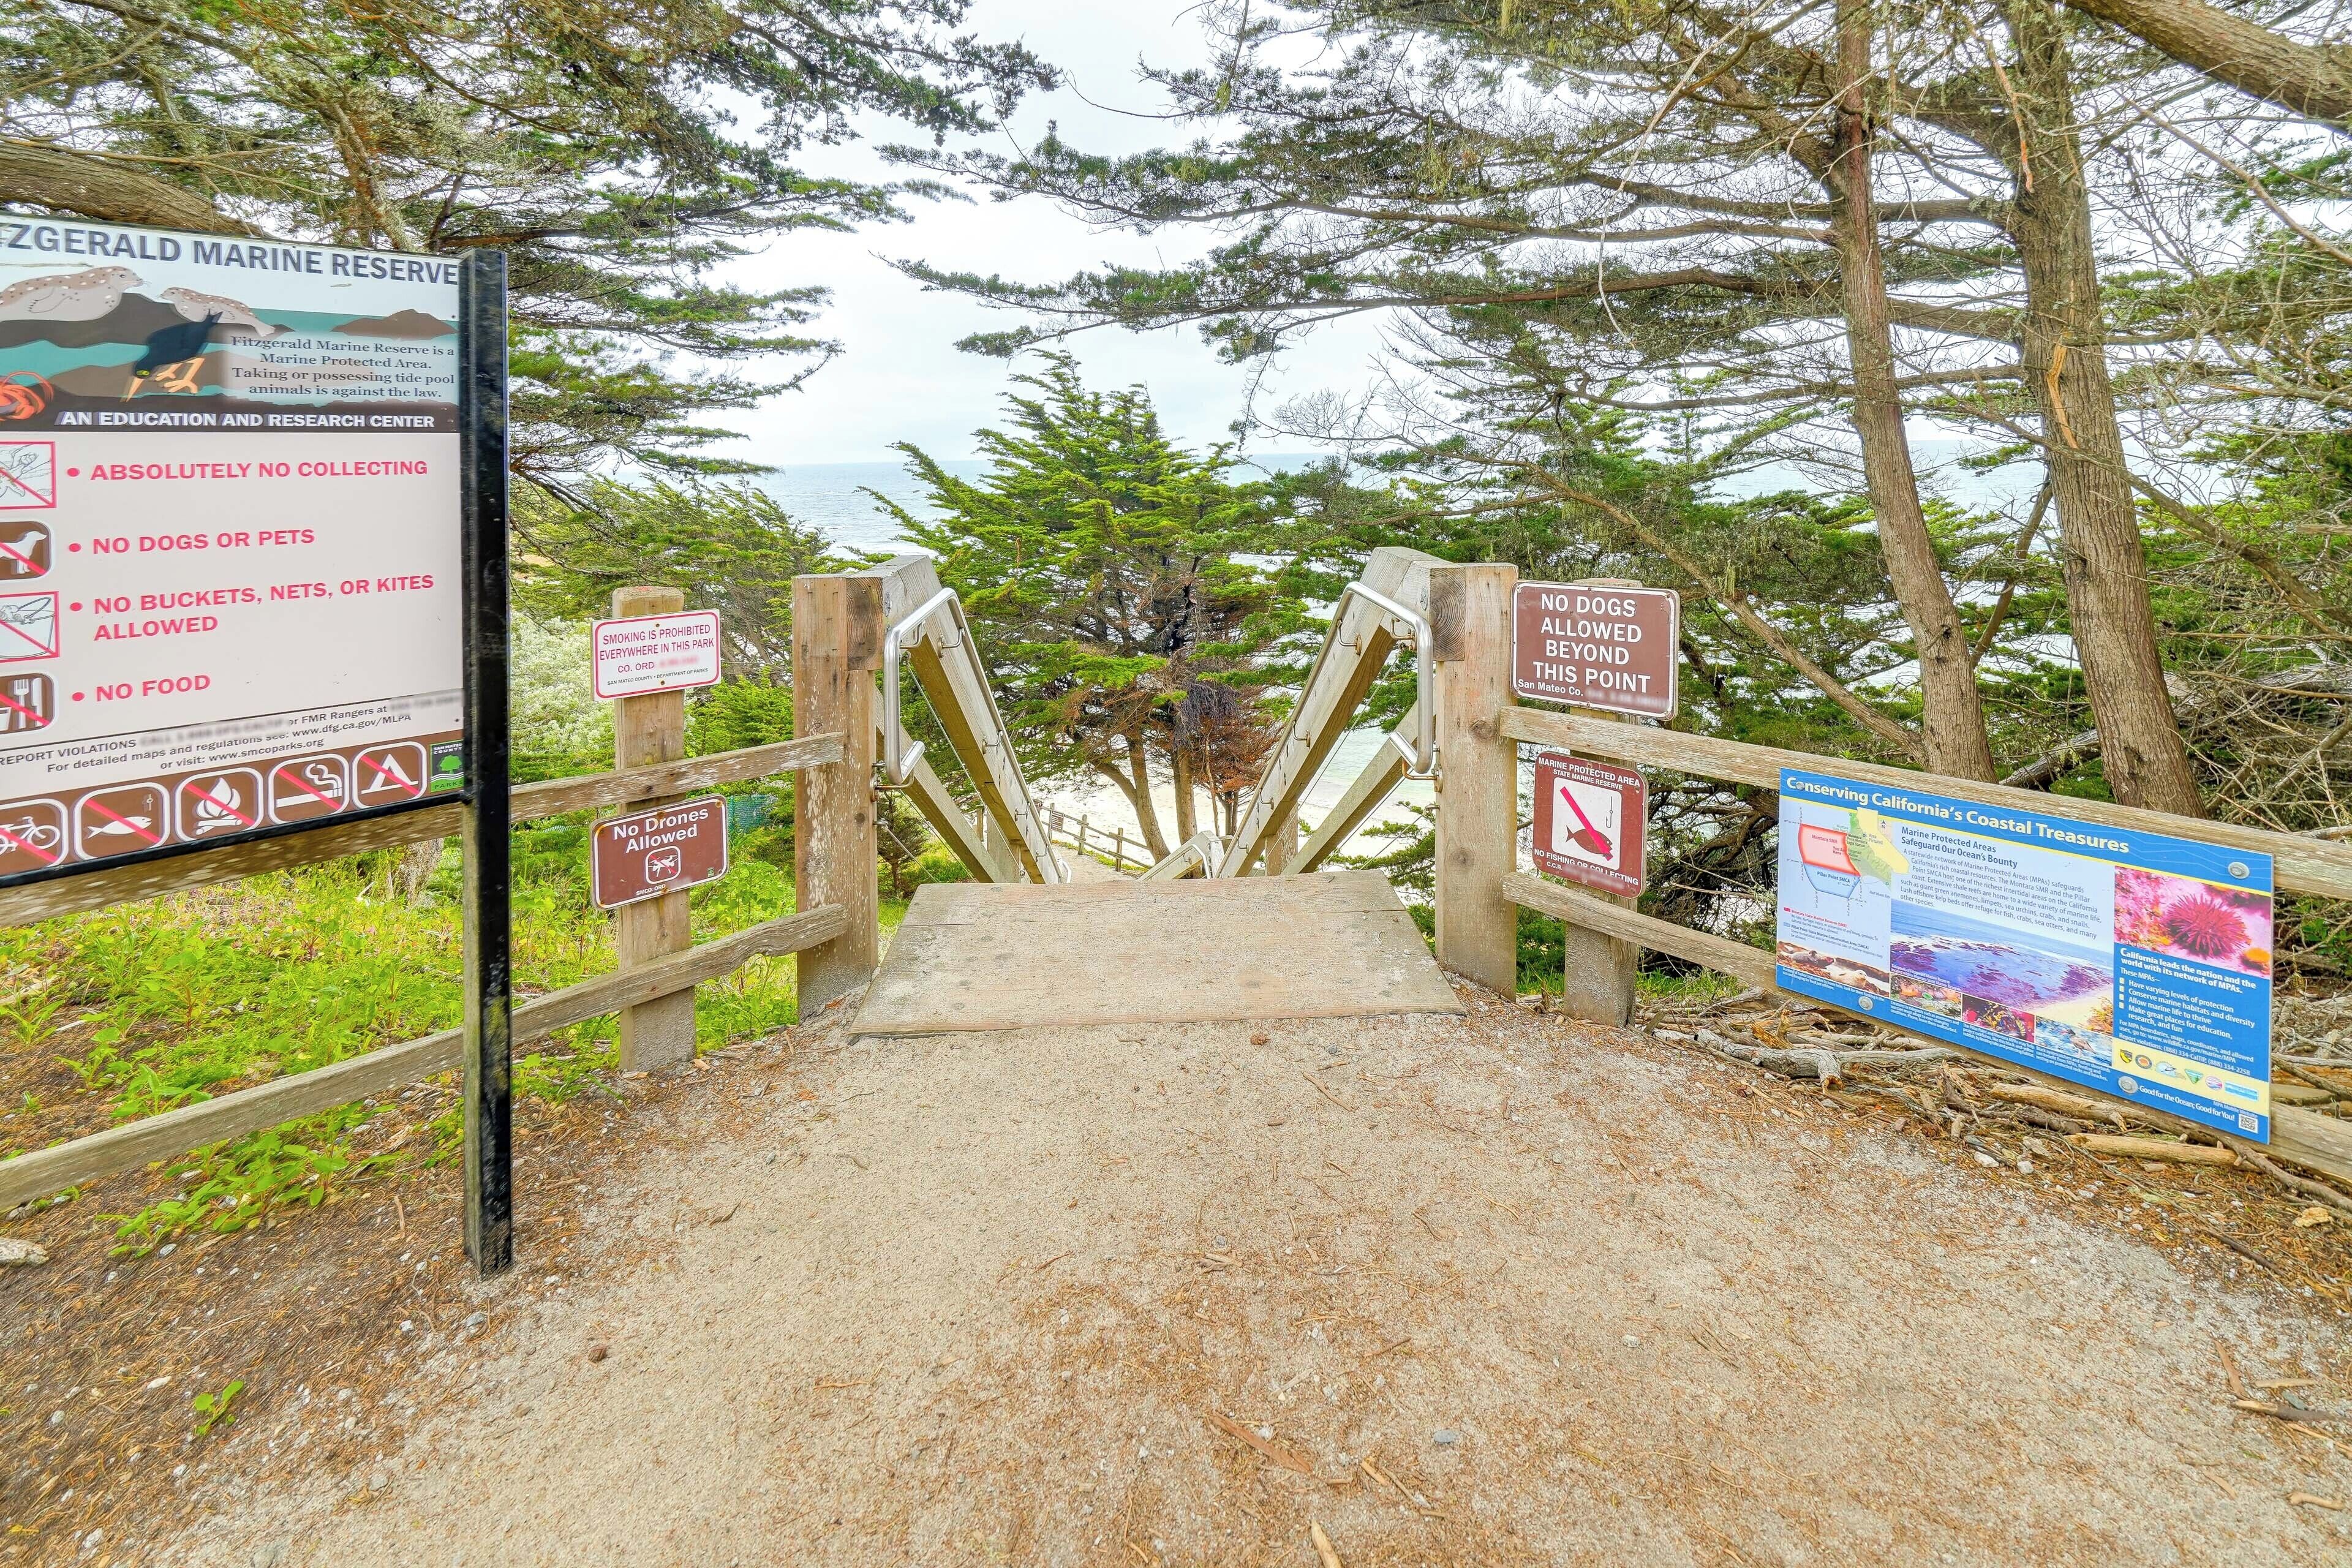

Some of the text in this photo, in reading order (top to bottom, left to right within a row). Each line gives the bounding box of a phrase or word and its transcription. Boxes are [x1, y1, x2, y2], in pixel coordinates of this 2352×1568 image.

[194, 240, 322, 274] MARINE
[331, 255, 459, 286] RESERVE
[232, 336, 312, 350] Fitzgerald
[317, 339, 369, 352] Marine
[374, 342, 429, 354] Reserve
[433, 345, 443, 355] is
[260, 353, 431, 368] Marine Protected Area.
[232, 368, 286, 381] Taking
[313, 373, 391, 385] possessing
[396, 373, 421, 383] tide
[426, 374, 454, 386] pool
[249, 384, 442, 399] animals is against the law.
[61, 411, 435, 428] AN EDUCATION AND RESEARCH CENTER
[91, 461, 428, 480] ABSOLUTELY NO COLLECTING
[93, 529, 315, 554] NO DOGS OR PETS
[94, 575, 434, 614] NO BUCKETS, NETS, OR KITES
[1541, 594, 1637, 617] NO DOGS
[94, 616, 218, 641] ALLOWED
[603, 624, 710, 645] SMOKING IS PROHIBITED
[1540, 617, 1642, 643] ALLOWED
[600, 638, 714, 660] EVERYWHERE IN THIS PARK
[1546, 639, 1629, 665] BEYOND
[618, 665, 633, 673] CO.
[636, 662, 654, 671] ORD
[1533, 662, 1651, 693] THIS POINT
[96, 675, 211, 703] NO FOOD
[1518, 679, 1583, 696] San Mateo Co.
[0, 751, 54, 765] REPORT
[58, 739, 137, 757] VIOLATIONS
[301, 714, 326, 724] FMR
[331, 707, 374, 720] Rangers
[377, 705, 387, 714] at
[47, 763, 70, 772] For
[74, 754, 127, 767] detailed
[132, 750, 166, 760] maps
[170, 745, 192, 755] and
[196, 736, 262, 751] regulations
[292, 714, 411, 737] www.dfg.ca.gov/MLPA
[160, 738, 324, 769] or visit: www.smcoparks.org
[435, 780, 462, 789] PARKS
[1539, 757, 1640, 787] MARINE PROTECTED AREA
[1553, 769, 1623, 791] STATE MARINE RESERVE
[614, 809, 709, 840] No Drones
[1787, 777, 2130, 853] Cnserving California's Coastal Treasures
[625, 824, 698, 854] Allowed
[1902, 827, 1996, 853] Marine Protected Areas
[1534, 848, 1545, 858] NO
[1547, 851, 1575, 865] FISHING
[1902, 837, 2018, 869] Safeguard Our Ocean's Bounty
[2120, 948, 2256, 989] California leads the nation and the
[2120, 967, 2137, 978] These
[2120, 958, 2243, 994] world with its network of MPAs.
[2128, 980, 2234, 1013] Have varying levels of protection
[2128, 988, 2255, 1028] Conserve marine habitats and diversity
[2128, 997, 2146, 1006] Allow
[2147, 1002, 2170, 1012] marine
[2171, 1007, 2182, 1016] life
[2192, 1014, 2212, 1025] thrive
[2128, 1005, 2146, 1016] Make
[2147, 1011, 2163, 1022] great
[2165, 1015, 2185, 1027] places
[2186, 1020, 2196, 1029] for
[2128, 1013, 2182, 1033] research, and fun
[2165, 1094, 2174, 1102] the
[2174, 1096, 2195, 1109] Ocean;
[2195, 1103, 2212, 1114] Good
[2212, 1108, 2221, 1117] for
[2222, 1111, 2235, 1121] You!
